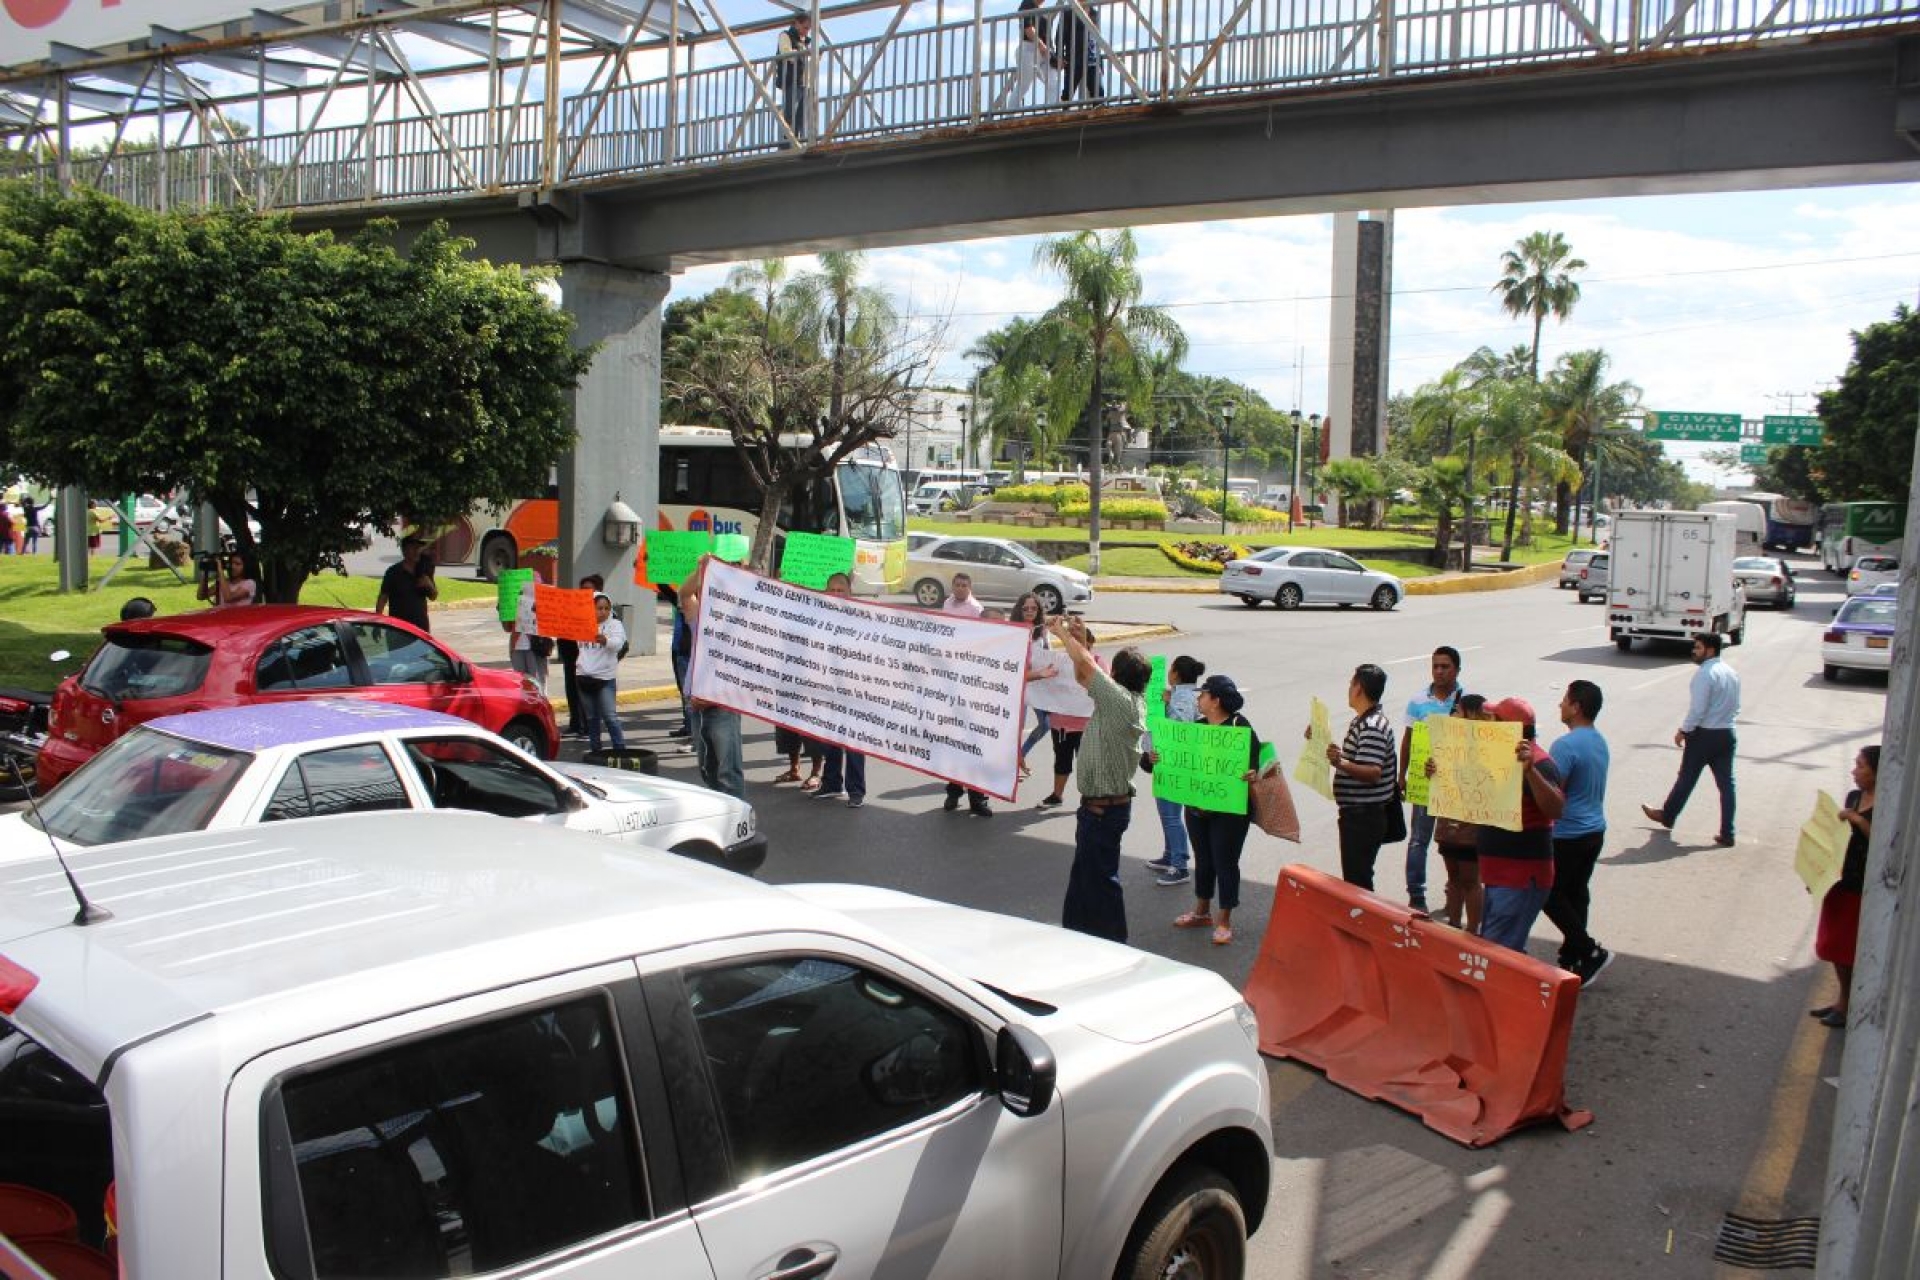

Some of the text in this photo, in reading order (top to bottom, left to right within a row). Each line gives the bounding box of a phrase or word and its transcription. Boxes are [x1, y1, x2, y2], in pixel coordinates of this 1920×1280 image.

[1663, 423, 1738, 433] CUAUTLA
[1669, 415, 1733, 424] CIVAC
[714, 515, 742, 535] bus
[1682, 529, 1699, 540] 65
[755, 581, 783, 597] SOMOS
[785, 590, 811, 605] GENTE
[875, 613, 888, 623] NO
[739, 598, 749, 608] por
[750, 601, 763, 612] que
[765, 606, 778, 616] nos
[779, 610, 817, 626] mandaste
[824, 621, 834, 631] tu
[834, 625, 855, 637] gente
[882, 633, 906, 648] fuerza
[1003, 660, 1019, 672] del
[725, 614, 747, 628] cuando
[749, 622, 778, 637] nosotros
[811, 640, 824, 650] una
[874, 655, 885, 666] de
[888, 657, 900, 669] 35
[931, 667, 958, 682] nunca
[960, 674, 1009, 695] notificaste
[737, 638, 754, 650] todos
[755, 644, 785, 660] nuestros
[785, 654, 820, 671] productos
[829, 666, 860, 681] comida
[875, 678, 891, 687] nos
[923, 687, 948, 702] perder
[957, 695, 966, 707] la
[969, 700, 1000, 716] verdad
[781, 672, 793, 683] por
[864, 690, 891, 706] fuerza
[926, 709, 935, 721] tu
[969, 722, 999, 739] cuando
[837, 723, 847, 735] de
[892, 743, 907, 753] del
[886, 720, 899, 730] por
[900, 724, 908, 734] el
